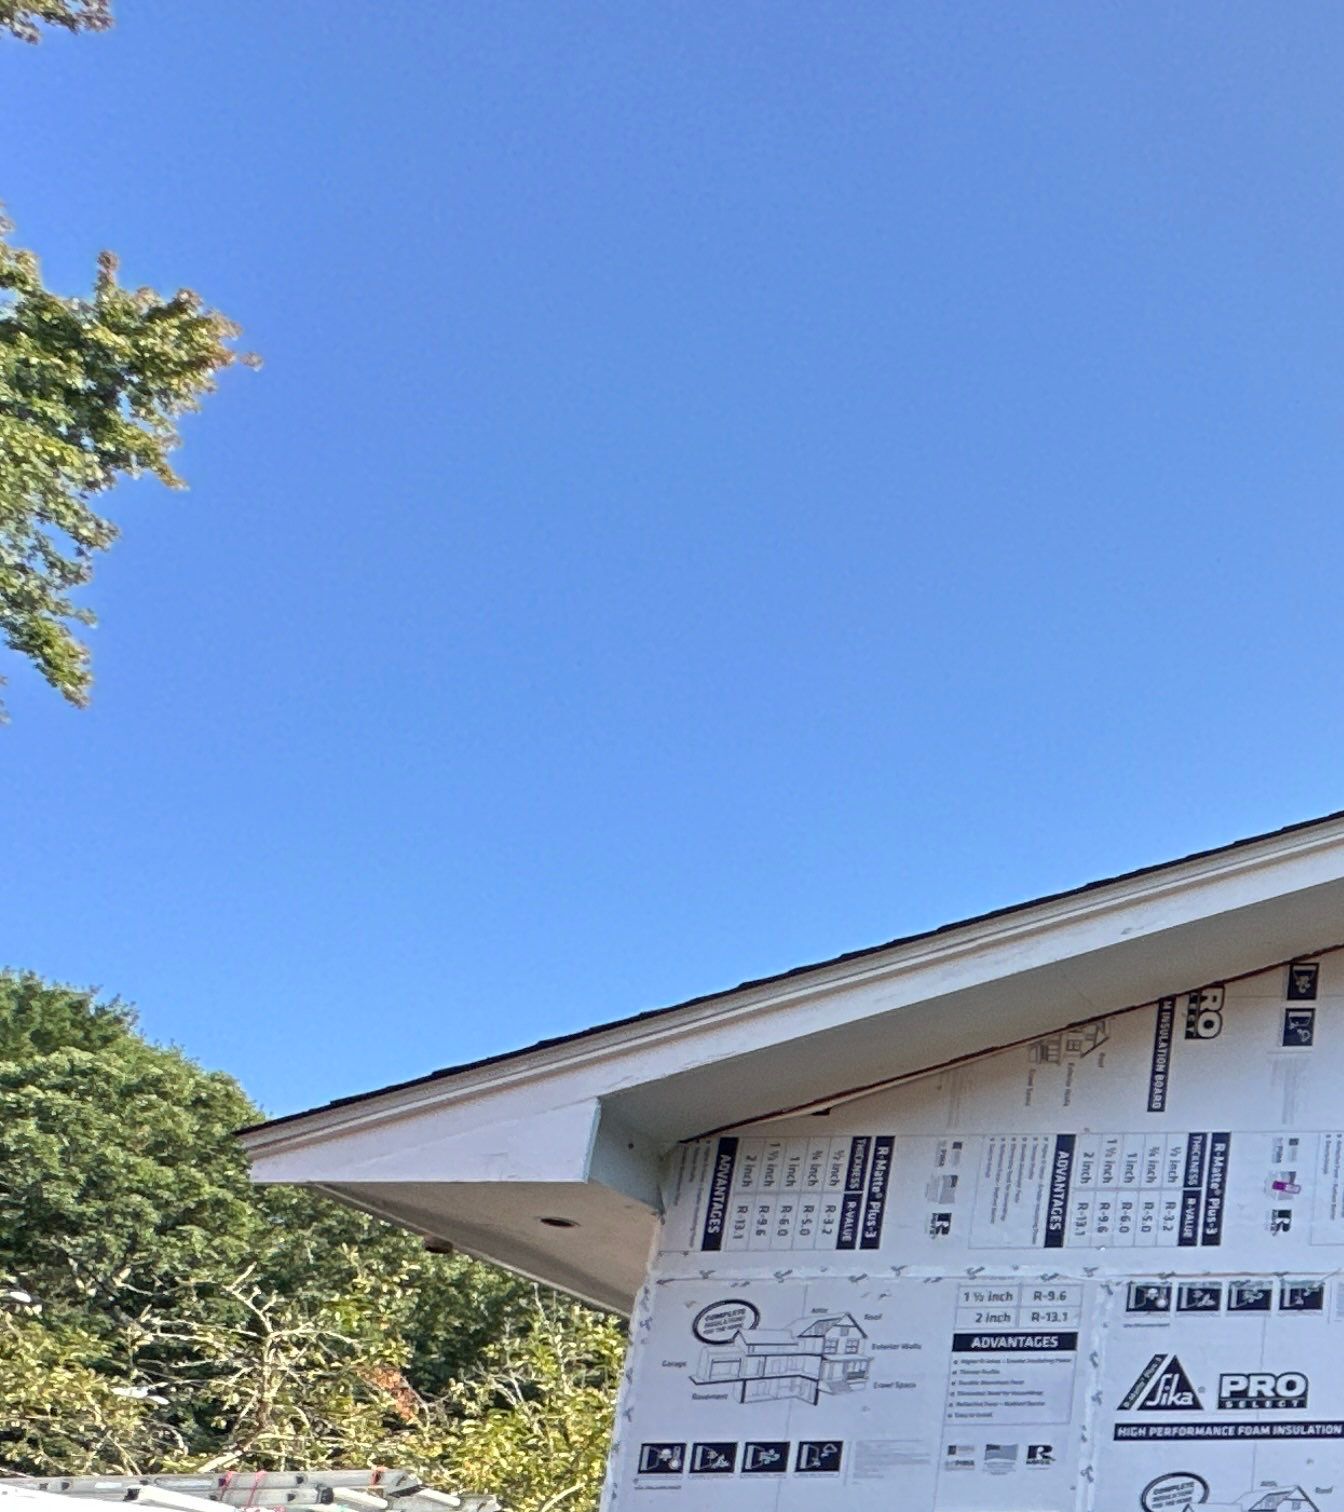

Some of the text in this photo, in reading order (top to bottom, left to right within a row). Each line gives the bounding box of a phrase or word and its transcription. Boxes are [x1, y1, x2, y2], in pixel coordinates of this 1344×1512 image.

[1048, 1150, 1070, 1231] ADVANTAGES
[1205, 1197, 1221, 1235] Plus-3
[970, 1335, 1058, 1349] ADVANTAGES
[1146, 1374, 1193, 1406] Sika
[1221, 1374, 1306, 1397] PRO
[1226, 1400, 1298, 1408] SELECT
[1117, 1426, 1146, 1437] HIGH
[1148, 1425, 1235, 1437] PERFORMANCE
[1237, 1425, 1270, 1436] FOAM
[1272, 1424, 1342, 1435] INSULATION
